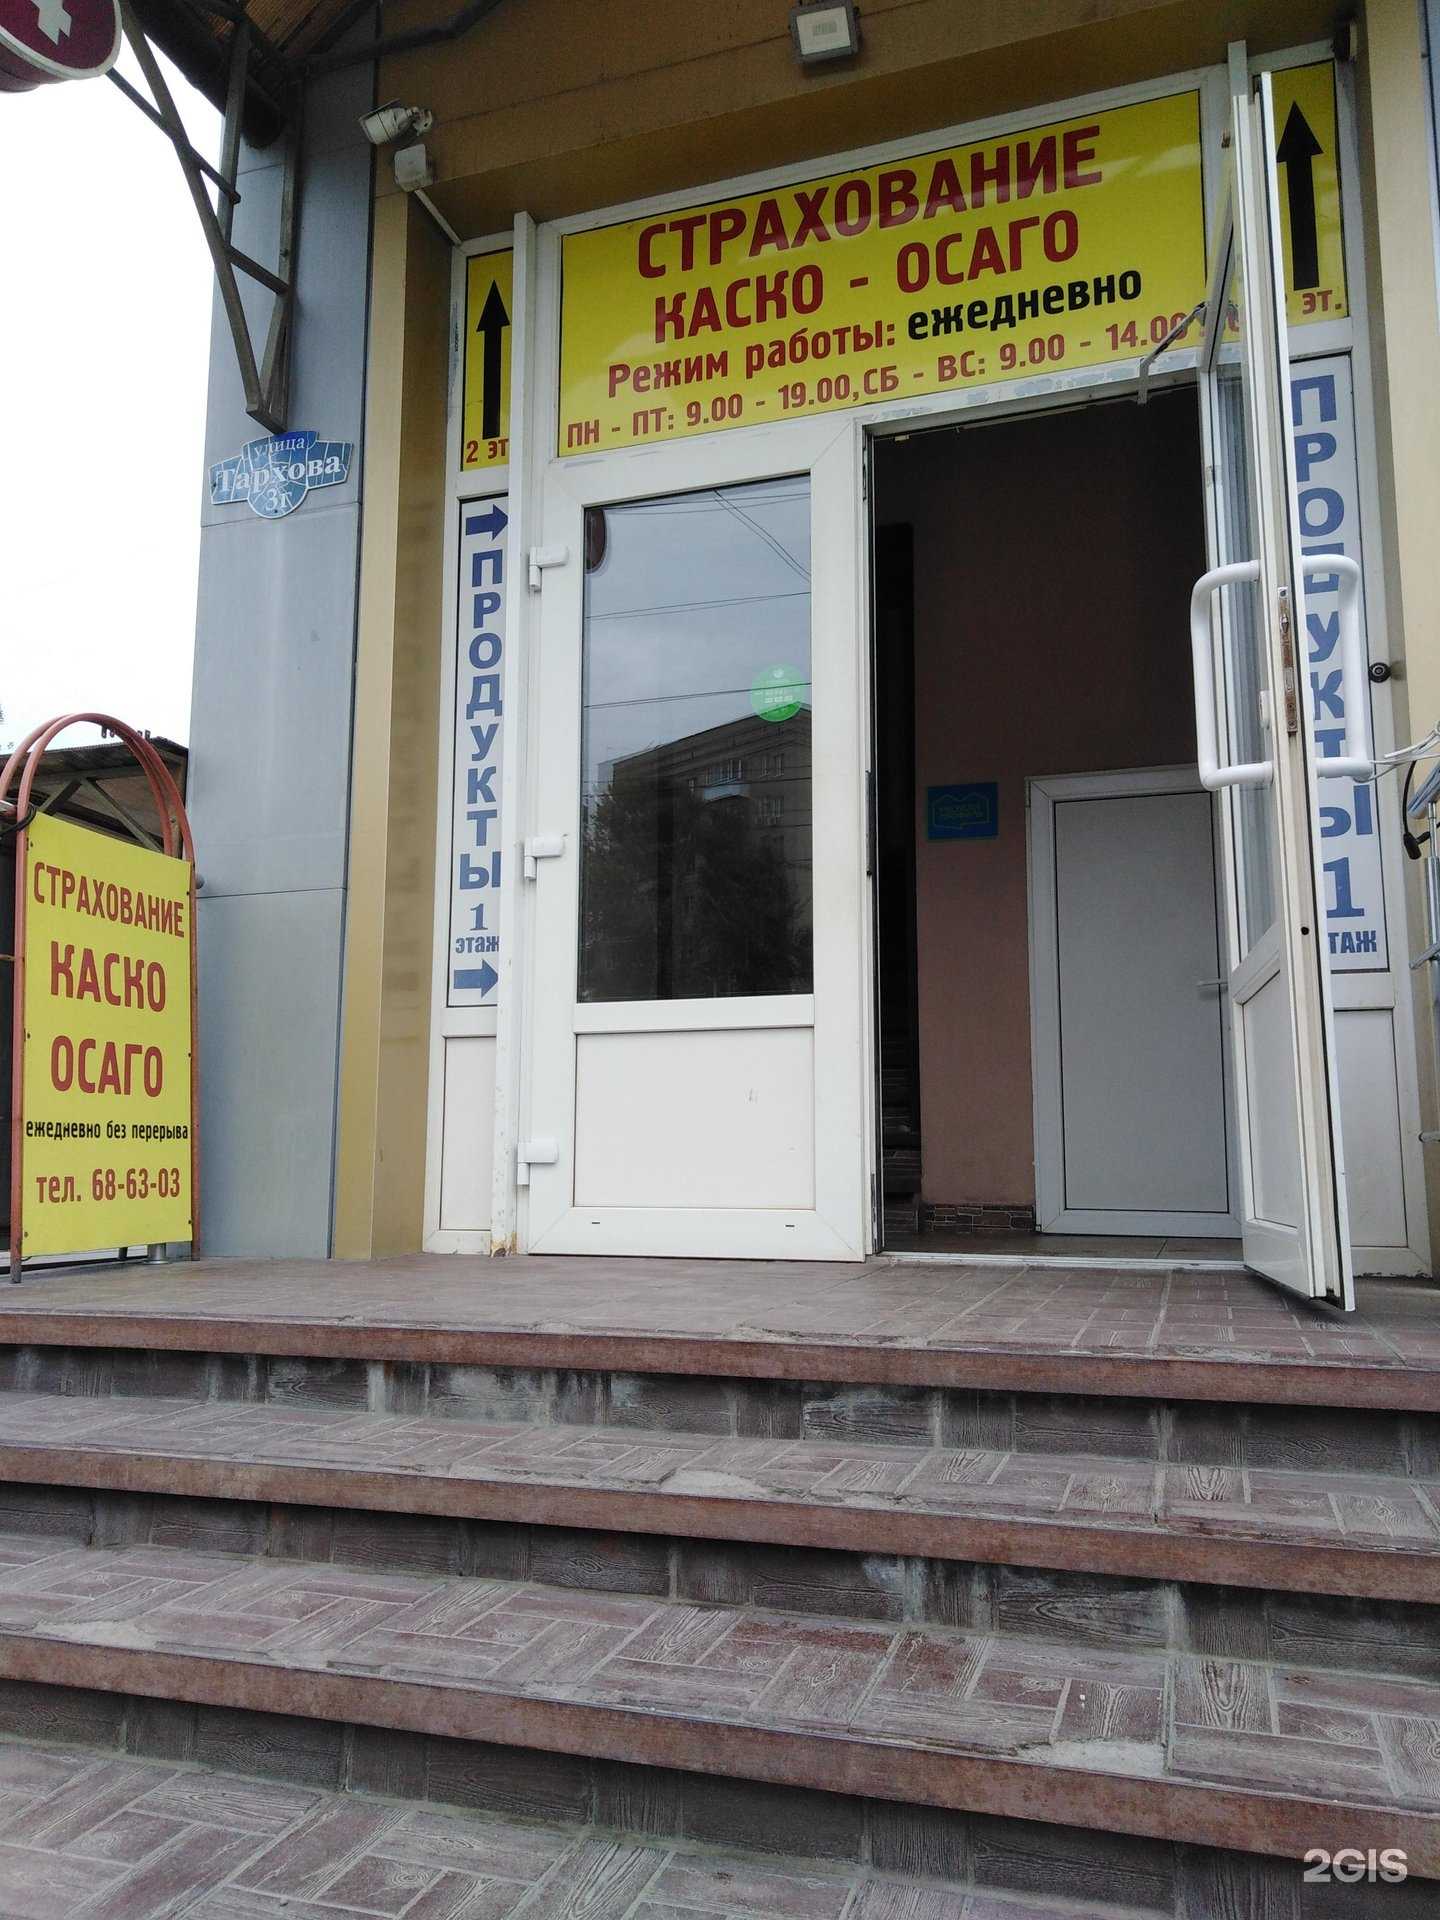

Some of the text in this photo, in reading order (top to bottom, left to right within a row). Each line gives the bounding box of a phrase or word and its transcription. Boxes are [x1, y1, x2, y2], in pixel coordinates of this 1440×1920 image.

[637, 125, 1103, 280] СТРАХОВАНИЕ
[653, 209, 1079, 344] КАСКО - ОСАГО
[608, 270, 1142, 399] Режим работы: ежедневно
[567, 419, 600, 449] ПН
[632, 406, 674, 437] ПТ:
[686, 393, 743, 428] 9.00
[937, 350, 986, 382] ВС:
[1000, 334, 1065, 371] 9.00
[1105, 311, 1189, 352] 14.00
[216, 455, 341, 494] Тархова
[254, 436, 306, 461] улица
[466, 440, 479, 463] 2
[459, 549, 502, 890] ПРОДУКТЫ
[33, 862, 185, 938] СТРАХОВАНИЕ
[470, 903, 489, 931] 1
[1323, 857, 1365, 919] 1
[1327, 930, 1377, 954] ТАЖ
[50, 941, 166, 1012] КАСКО
[50, 1035, 163, 1098] ОСАГО
[26, 1120, 188, 1142] ежедневно без перерыва
[36, 1167, 180, 1204] тел. 68-63-03
